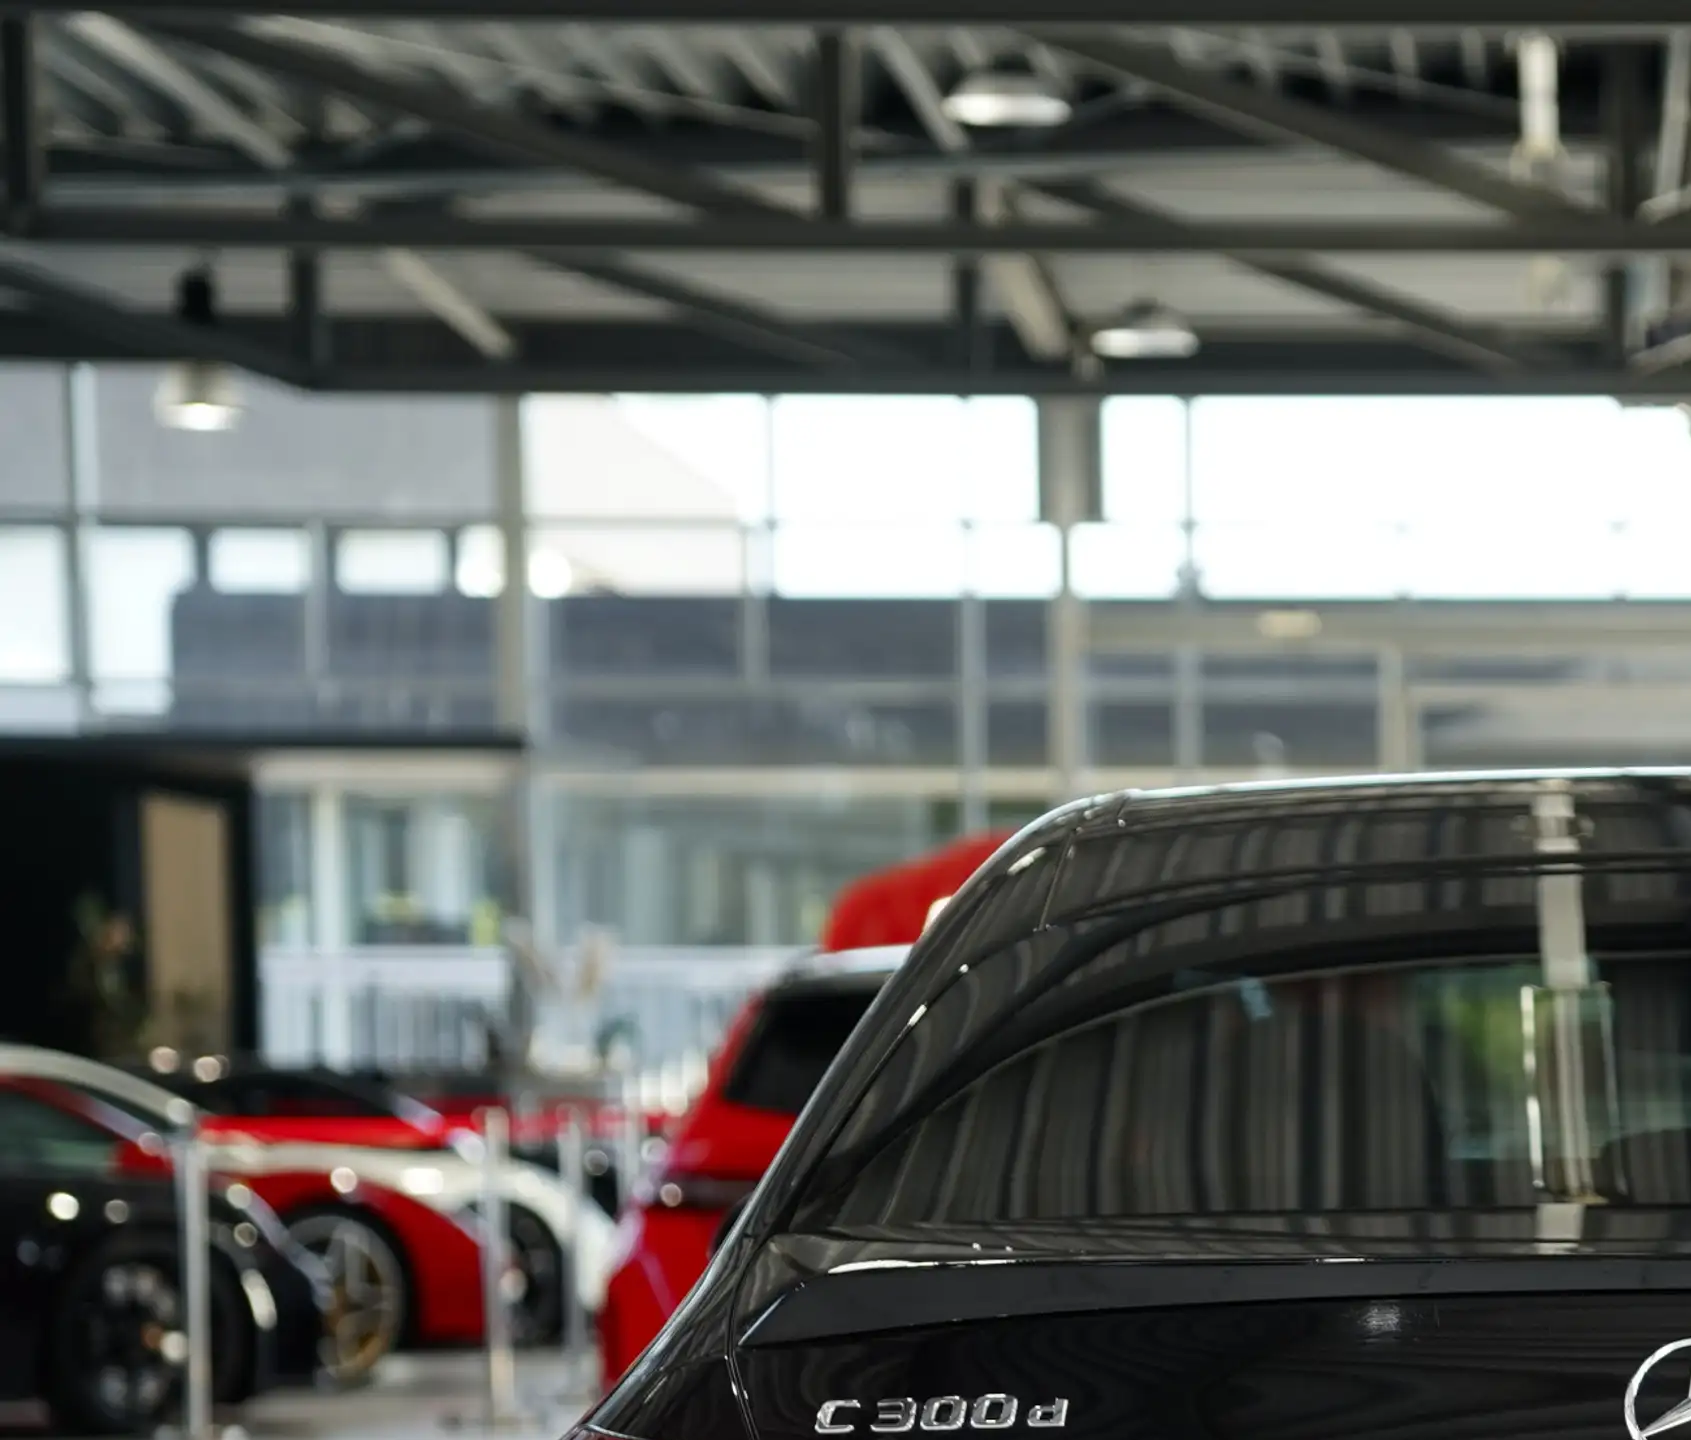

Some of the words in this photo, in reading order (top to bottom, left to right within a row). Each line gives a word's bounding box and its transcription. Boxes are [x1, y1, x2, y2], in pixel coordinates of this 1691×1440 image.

[815, 1400, 860, 1433] C
[870, 1394, 1018, 1432] 300
[1027, 1397, 1069, 1427] d
